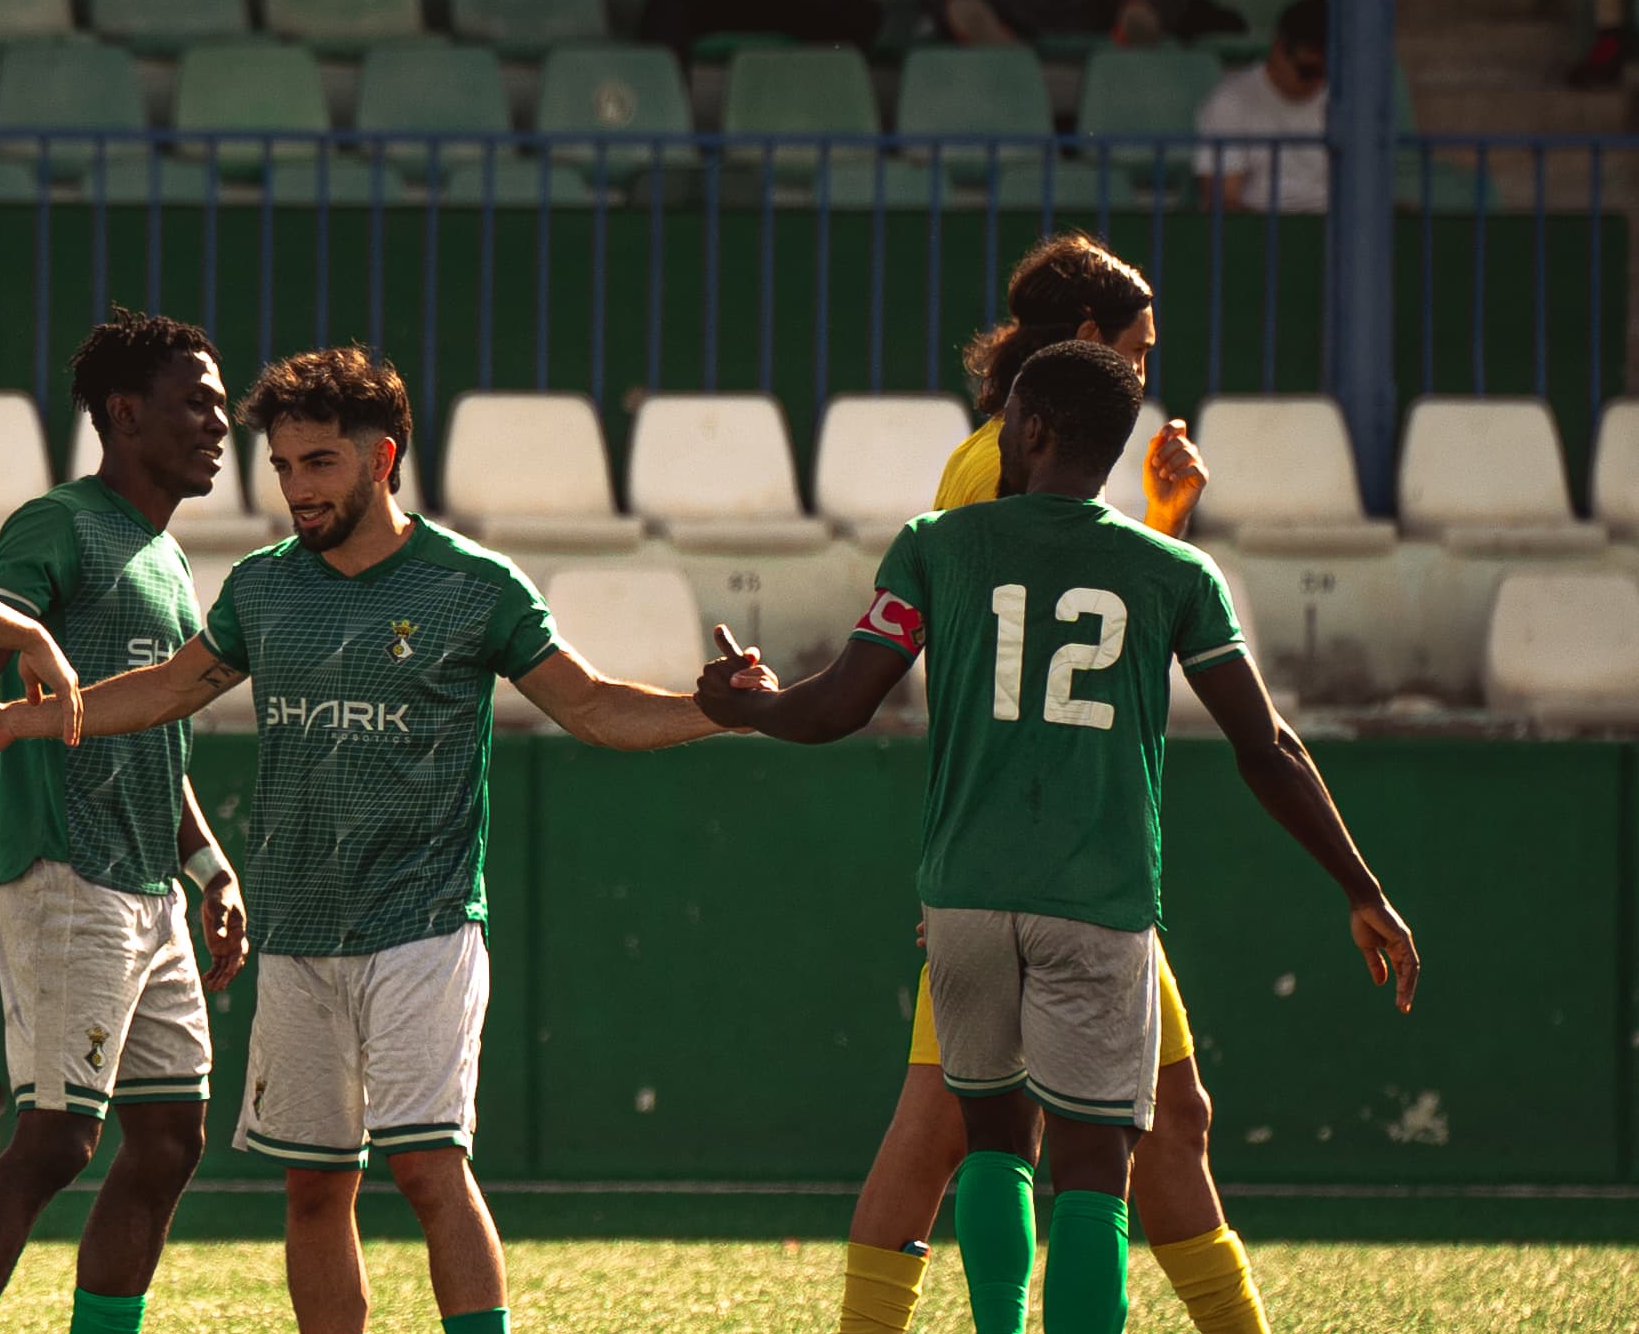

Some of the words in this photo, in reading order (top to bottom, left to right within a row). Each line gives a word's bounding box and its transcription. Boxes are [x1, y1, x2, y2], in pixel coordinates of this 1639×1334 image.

[992, 583, 1128, 731] 12
[266, 695, 410, 739] SHARK
[330, 732, 411, 744] ROBOTICS
